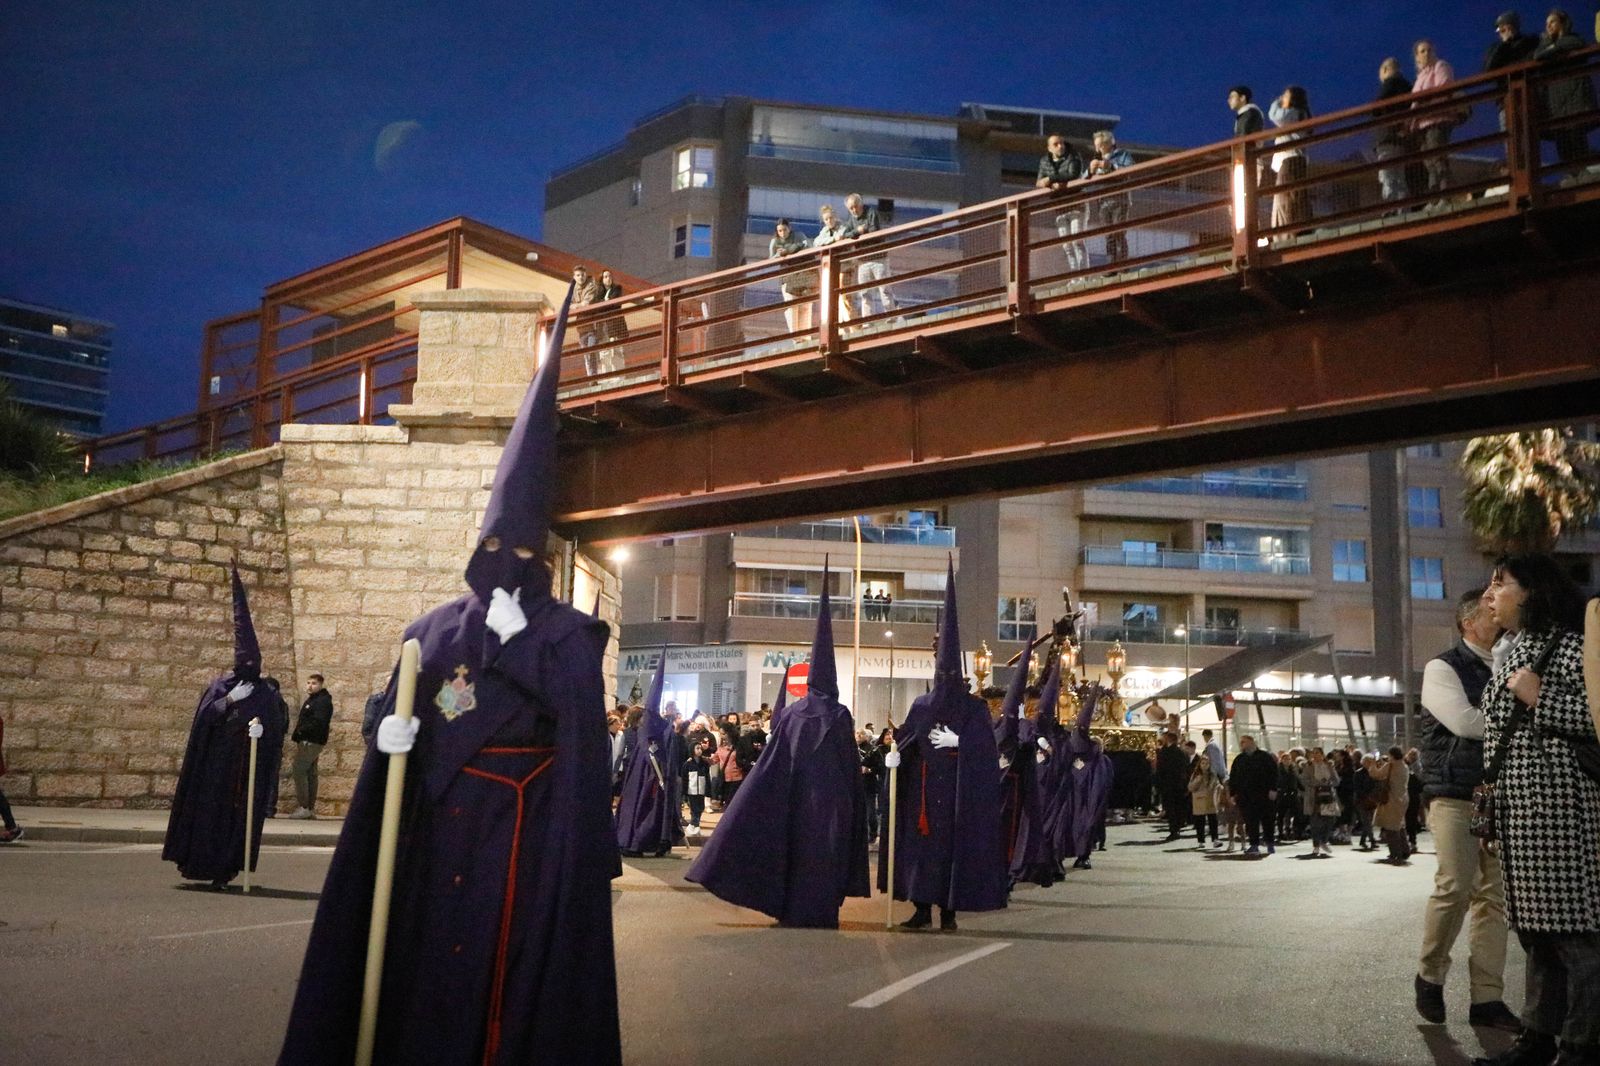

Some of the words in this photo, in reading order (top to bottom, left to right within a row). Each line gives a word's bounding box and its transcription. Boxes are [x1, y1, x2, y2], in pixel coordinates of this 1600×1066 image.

[684, 650, 715, 659] Nostrum
[715, 648, 743, 659] Estates
[625, 653, 660, 671] MNE
[678, 661, 729, 671] INMOBILIARIA
[858, 657, 934, 669] INMOBILIA
